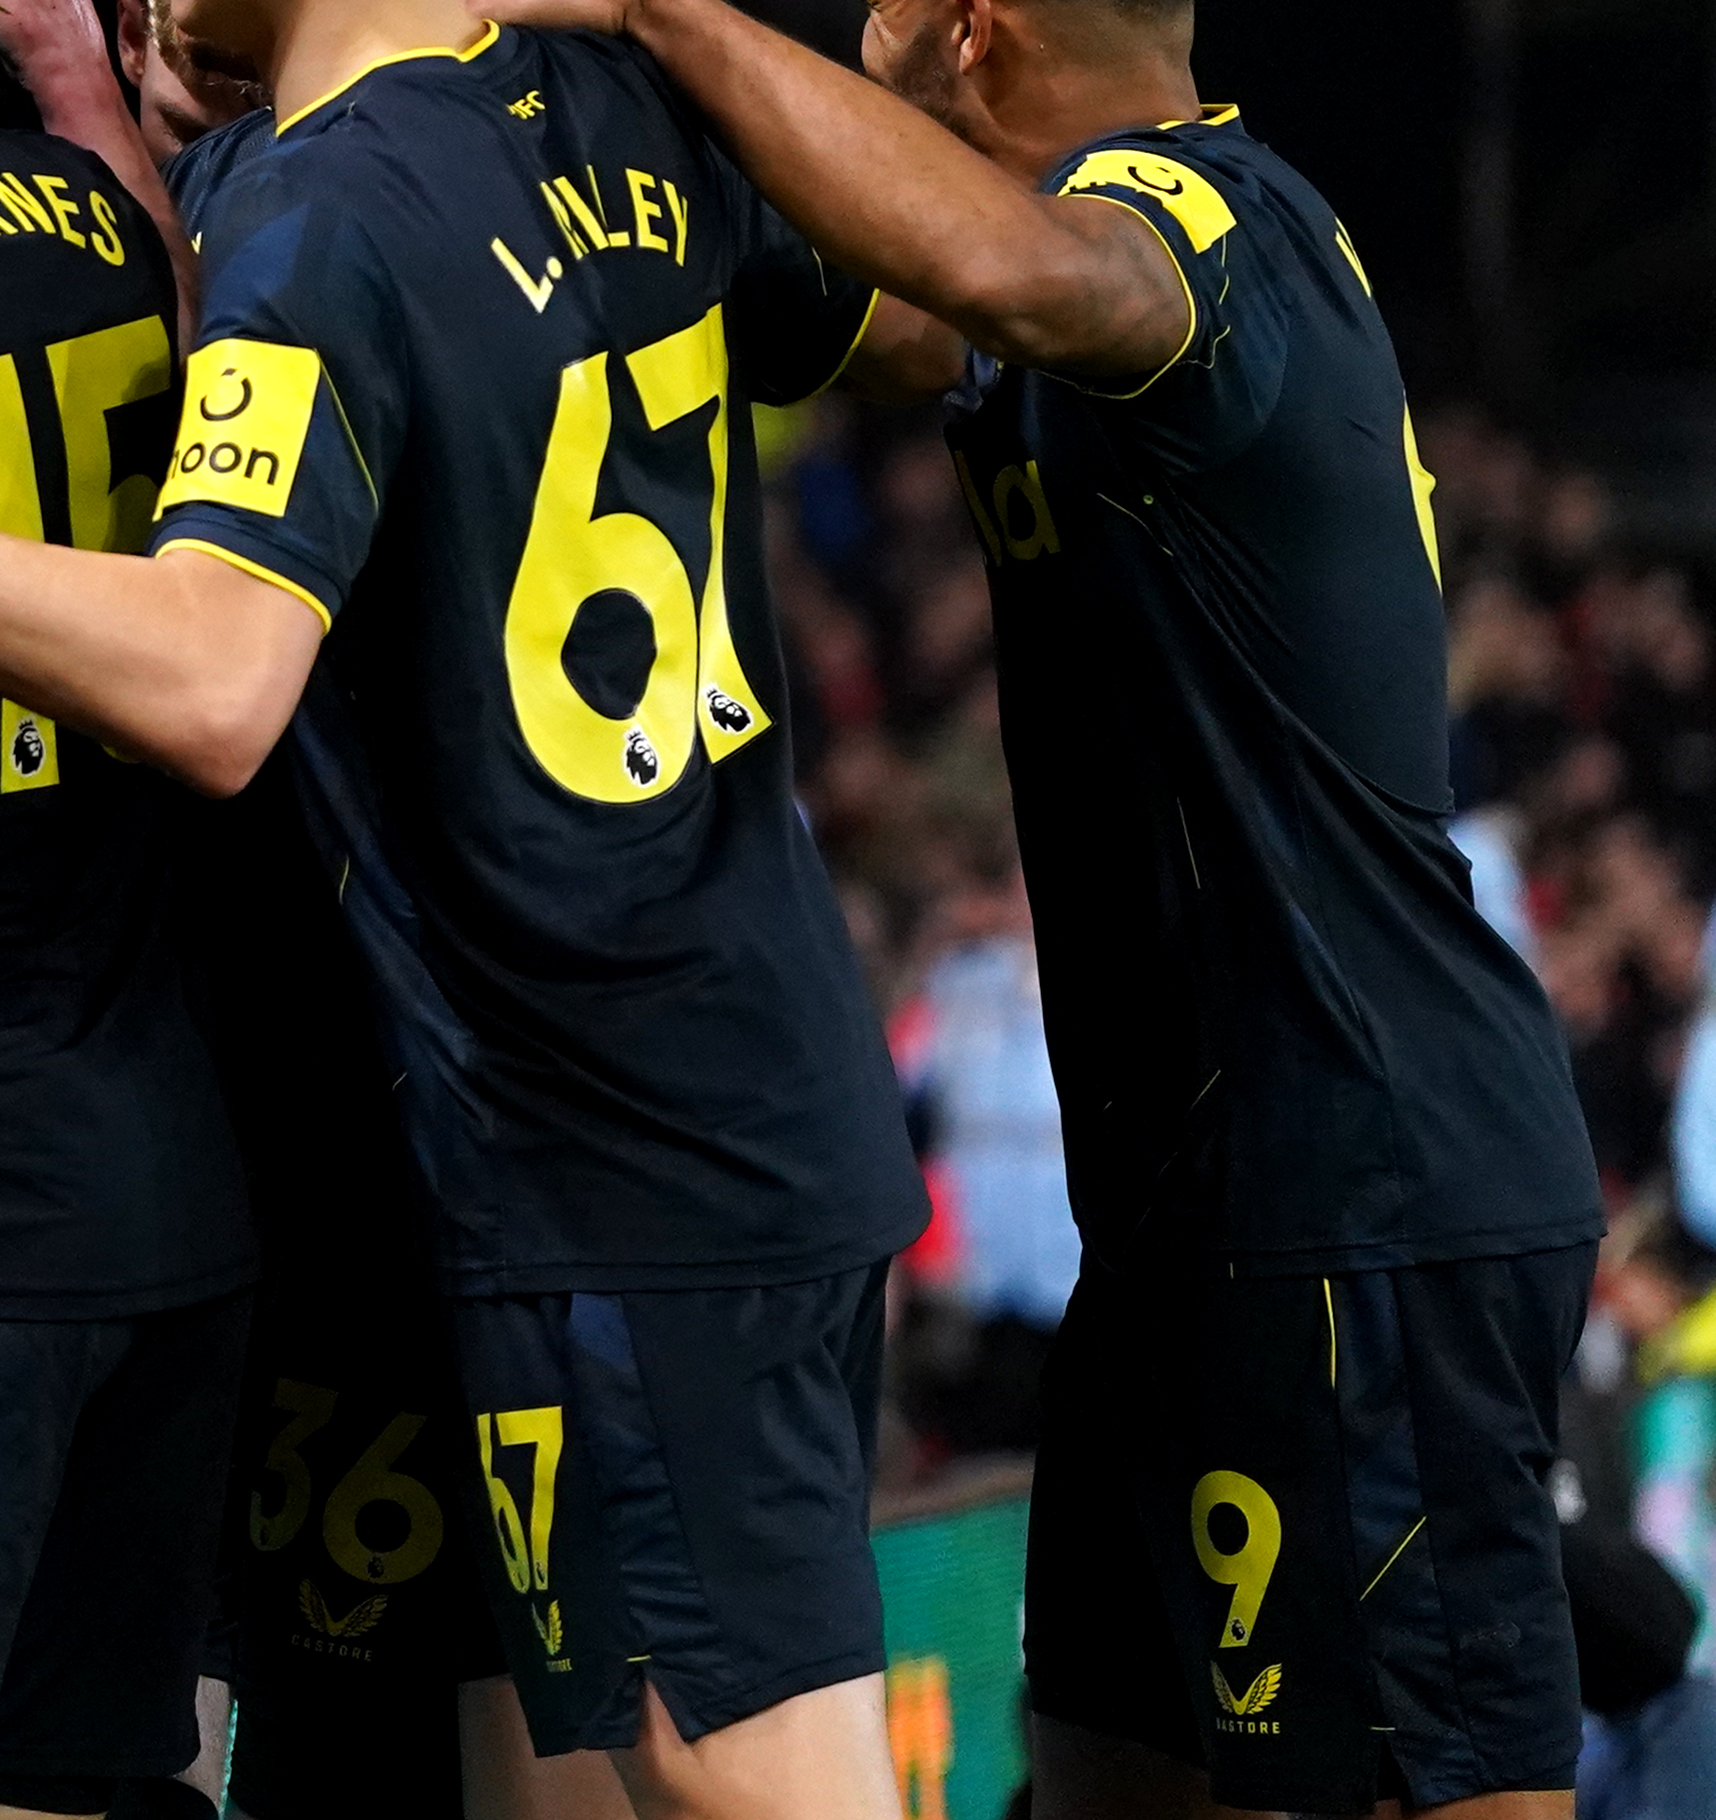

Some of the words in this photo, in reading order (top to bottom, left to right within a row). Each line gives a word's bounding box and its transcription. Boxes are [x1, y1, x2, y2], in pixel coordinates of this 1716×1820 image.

[503, 301, 776, 806] 67
[952, 448, 1062, 569] la
[249, 1376, 445, 1586] 36
[476, 1404, 564, 1594] 67
[1190, 1469, 1282, 1649] 9
